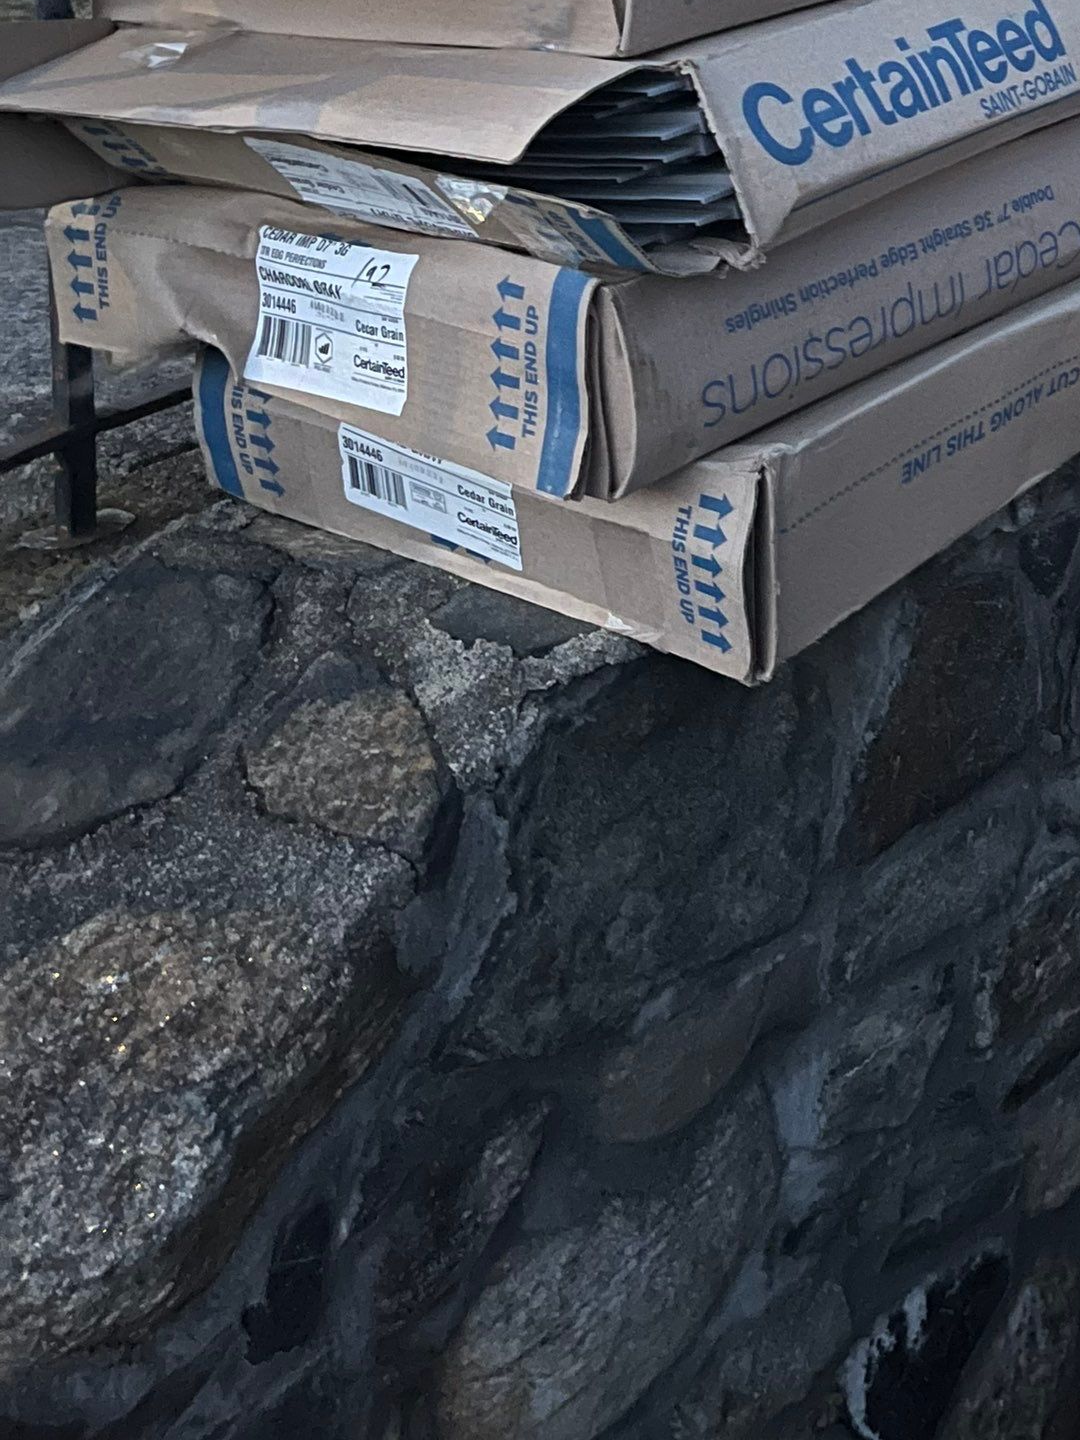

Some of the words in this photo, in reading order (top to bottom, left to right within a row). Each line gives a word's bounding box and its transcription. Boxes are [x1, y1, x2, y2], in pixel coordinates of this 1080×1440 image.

[980, 63, 1078, 119] SAINT-GOBAIN
[1011, 184, 1055, 214] Double
[262, 226, 295, 244] CEDAR
[295, 232, 318, 249] IMP
[918, 219, 973, 254] Straight
[973, 209, 994, 232] 3G
[94, 222, 108, 262] END
[880, 242, 919, 268] Edge
[97, 266, 110, 310] THIS
[259, 265, 313, 293] CHARCOAL
[313, 279, 343, 300] GRAY
[799, 258, 879, 303] Perfection
[525, 304, 540, 336] UP
[725, 292, 798, 334] Shingles
[381, 325, 404, 342] Grain
[701, 271, 965, 429] Impressions
[353, 354, 405, 379] CertainTeed
[524, 340, 539, 386] END
[1046, 366, 1080, 398] CUT
[521, 390, 539, 438] THIS
[990, 383, 1044, 433] ALONG
[232, 412, 248, 450] END
[946, 420, 986, 457] THIS
[239, 452, 254, 476] UP
[901, 444, 942, 485] LINE
[457, 484, 486, 505] Cedar
[488, 497, 515, 517] Grain
[457, 512, 518, 546] CertainTeed
[671, 505, 693, 554] THIS
[673, 555, 691, 597] END
[679, 597, 695, 625] UP
